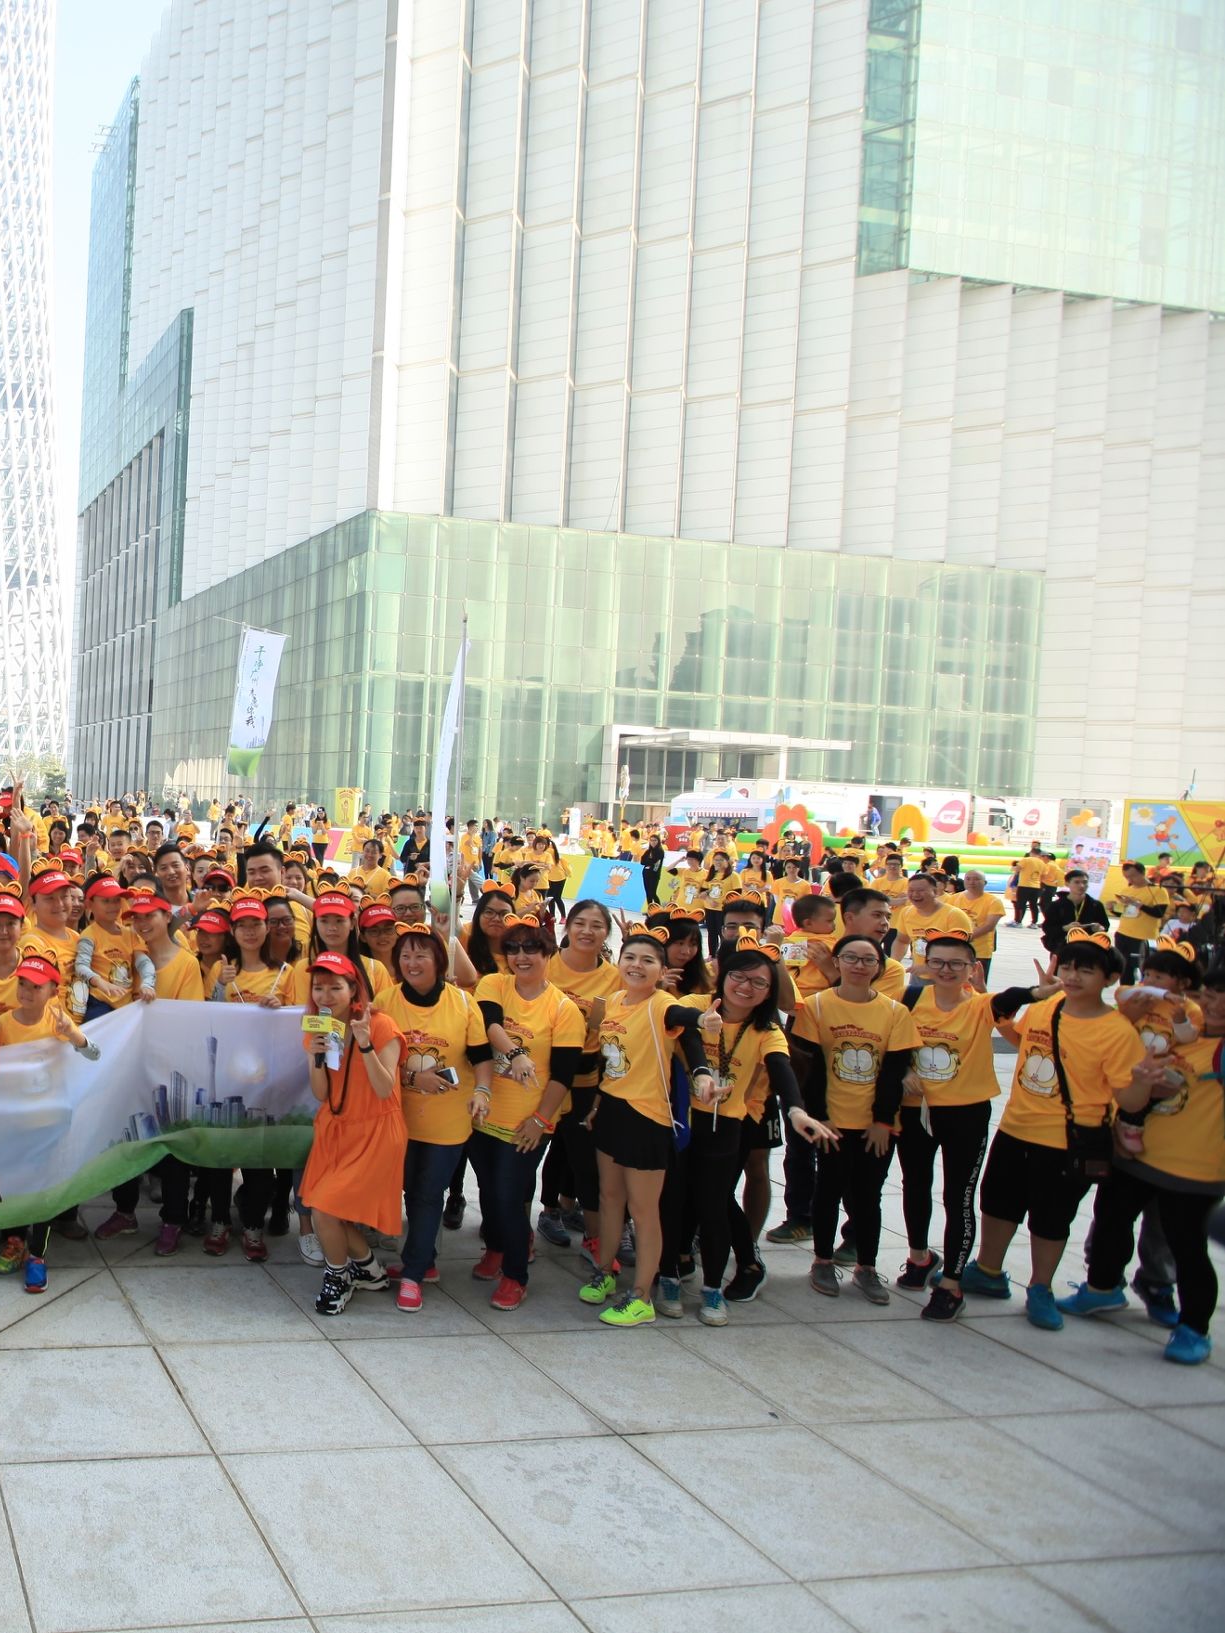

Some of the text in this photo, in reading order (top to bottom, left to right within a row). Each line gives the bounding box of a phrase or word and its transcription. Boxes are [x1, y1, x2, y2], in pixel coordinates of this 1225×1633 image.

[962, 1209, 971, 1218] TO
[963, 1219, 972, 1238] LOVE
[962, 1240, 971, 1250] BY
